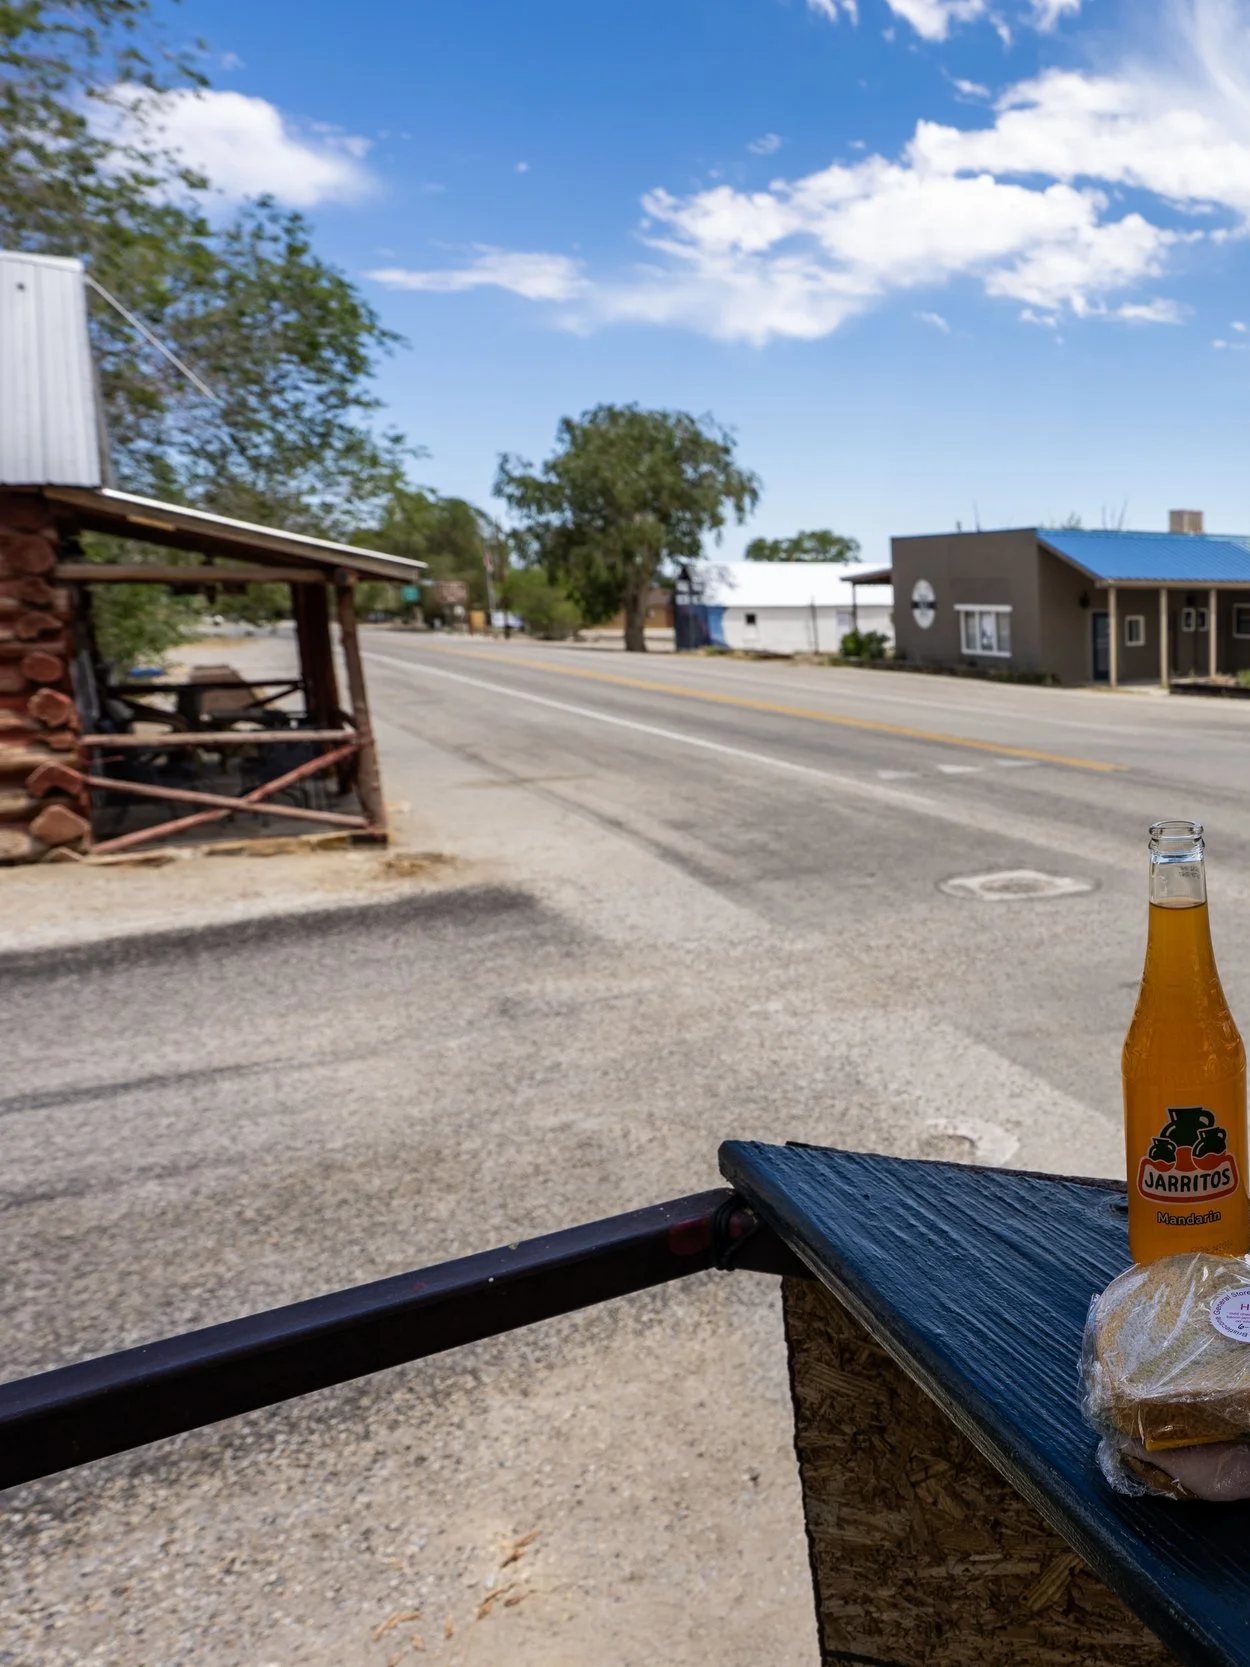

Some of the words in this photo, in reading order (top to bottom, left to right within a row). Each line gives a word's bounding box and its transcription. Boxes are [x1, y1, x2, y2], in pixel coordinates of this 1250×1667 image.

[1144, 1168, 1230, 1193] JARRITOS
[1157, 1210, 1221, 1226] Mandarin
[1213, 1294, 1231, 1315] General
[1231, 1290, 1250, 1298] Store
